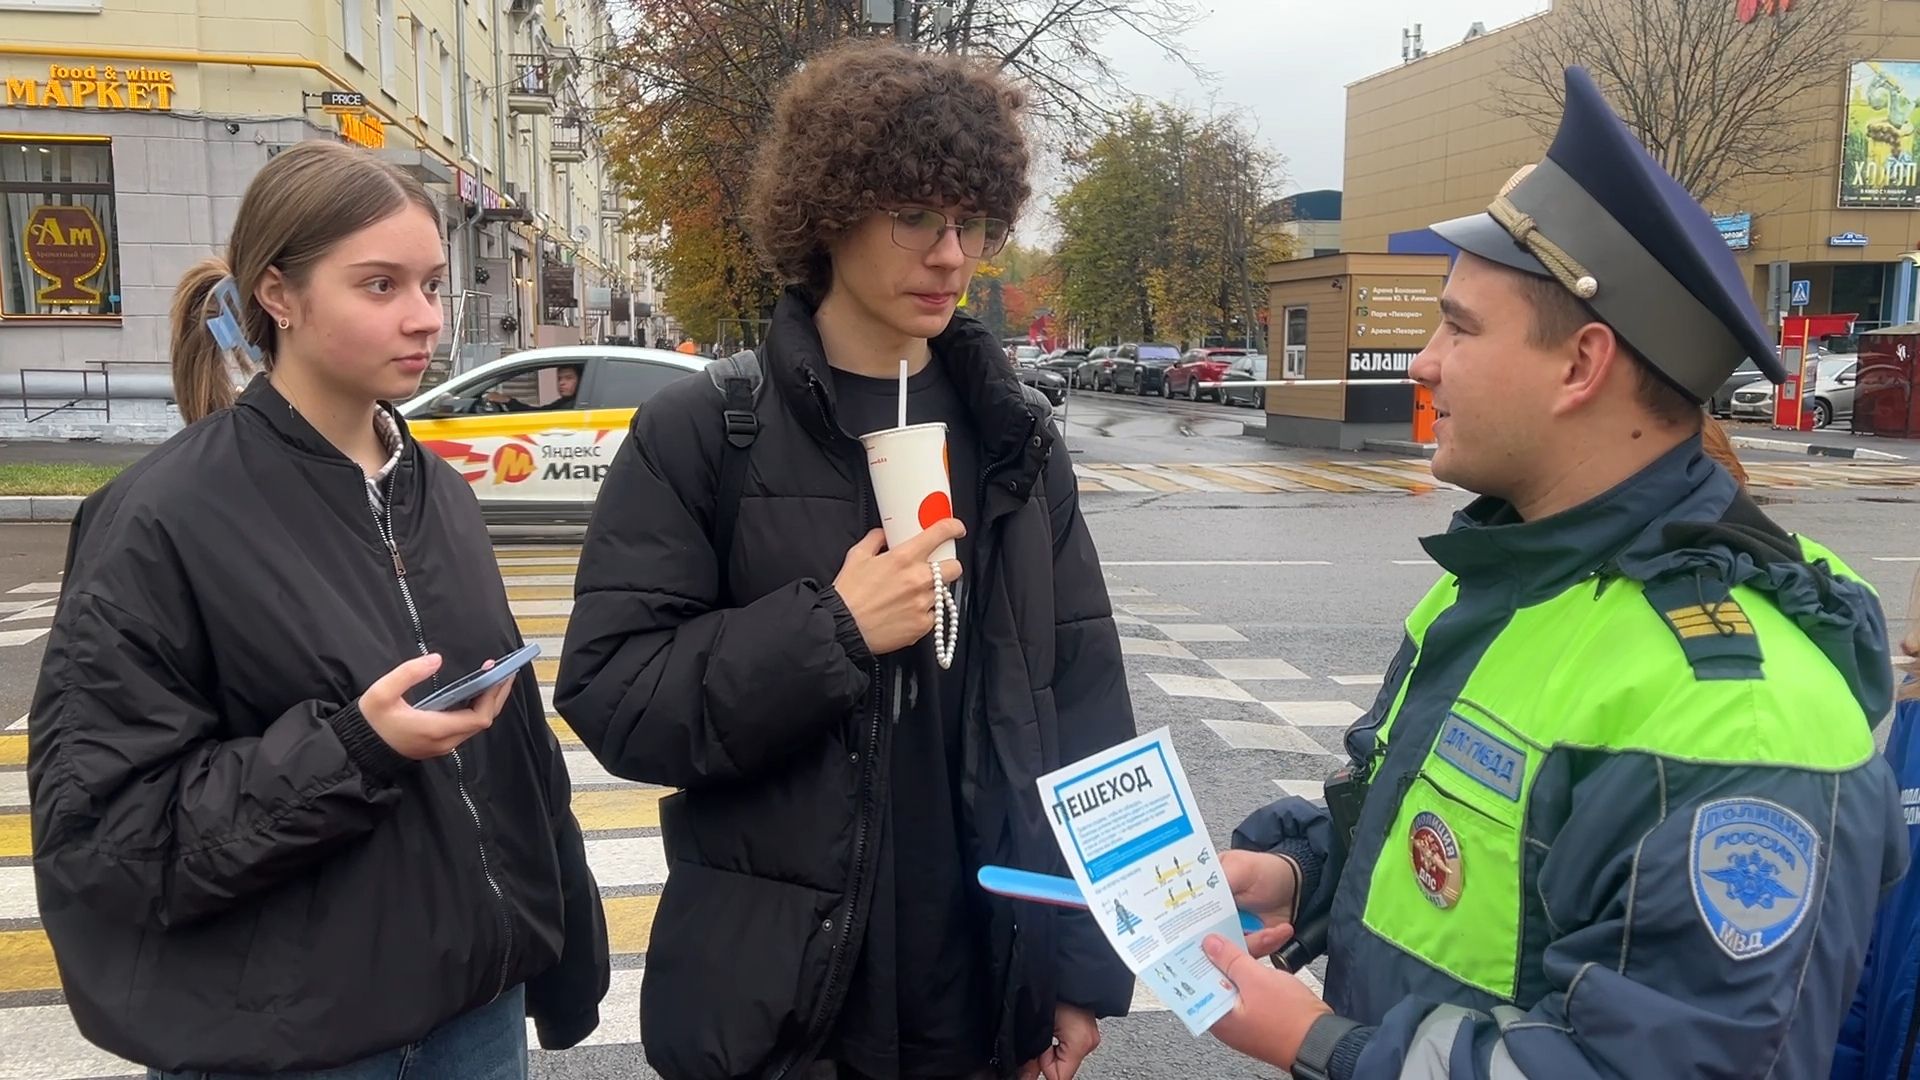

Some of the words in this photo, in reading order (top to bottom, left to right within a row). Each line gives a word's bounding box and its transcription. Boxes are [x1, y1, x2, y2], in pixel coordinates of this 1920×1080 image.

[50, 64, 97, 80] food
[104, 65, 117, 80] &
[126, 67, 172, 81] wine
[6, 79, 176, 111] МАРКЕТ
[332, 94, 361, 105] PRICE
[541, 444, 601, 459] Яндекс
[1469, 740, 1516, 785] ГИБДД
[1051, 765, 1153, 825] ПЕШЕХОД
[1414, 813, 1456, 858] ПОЛИЦИЯ
[1702, 805, 1811, 856] ПОЛИЦИЯ
[1419, 867, 1437, 891] ДПС
[1718, 921, 1763, 951] МВД
